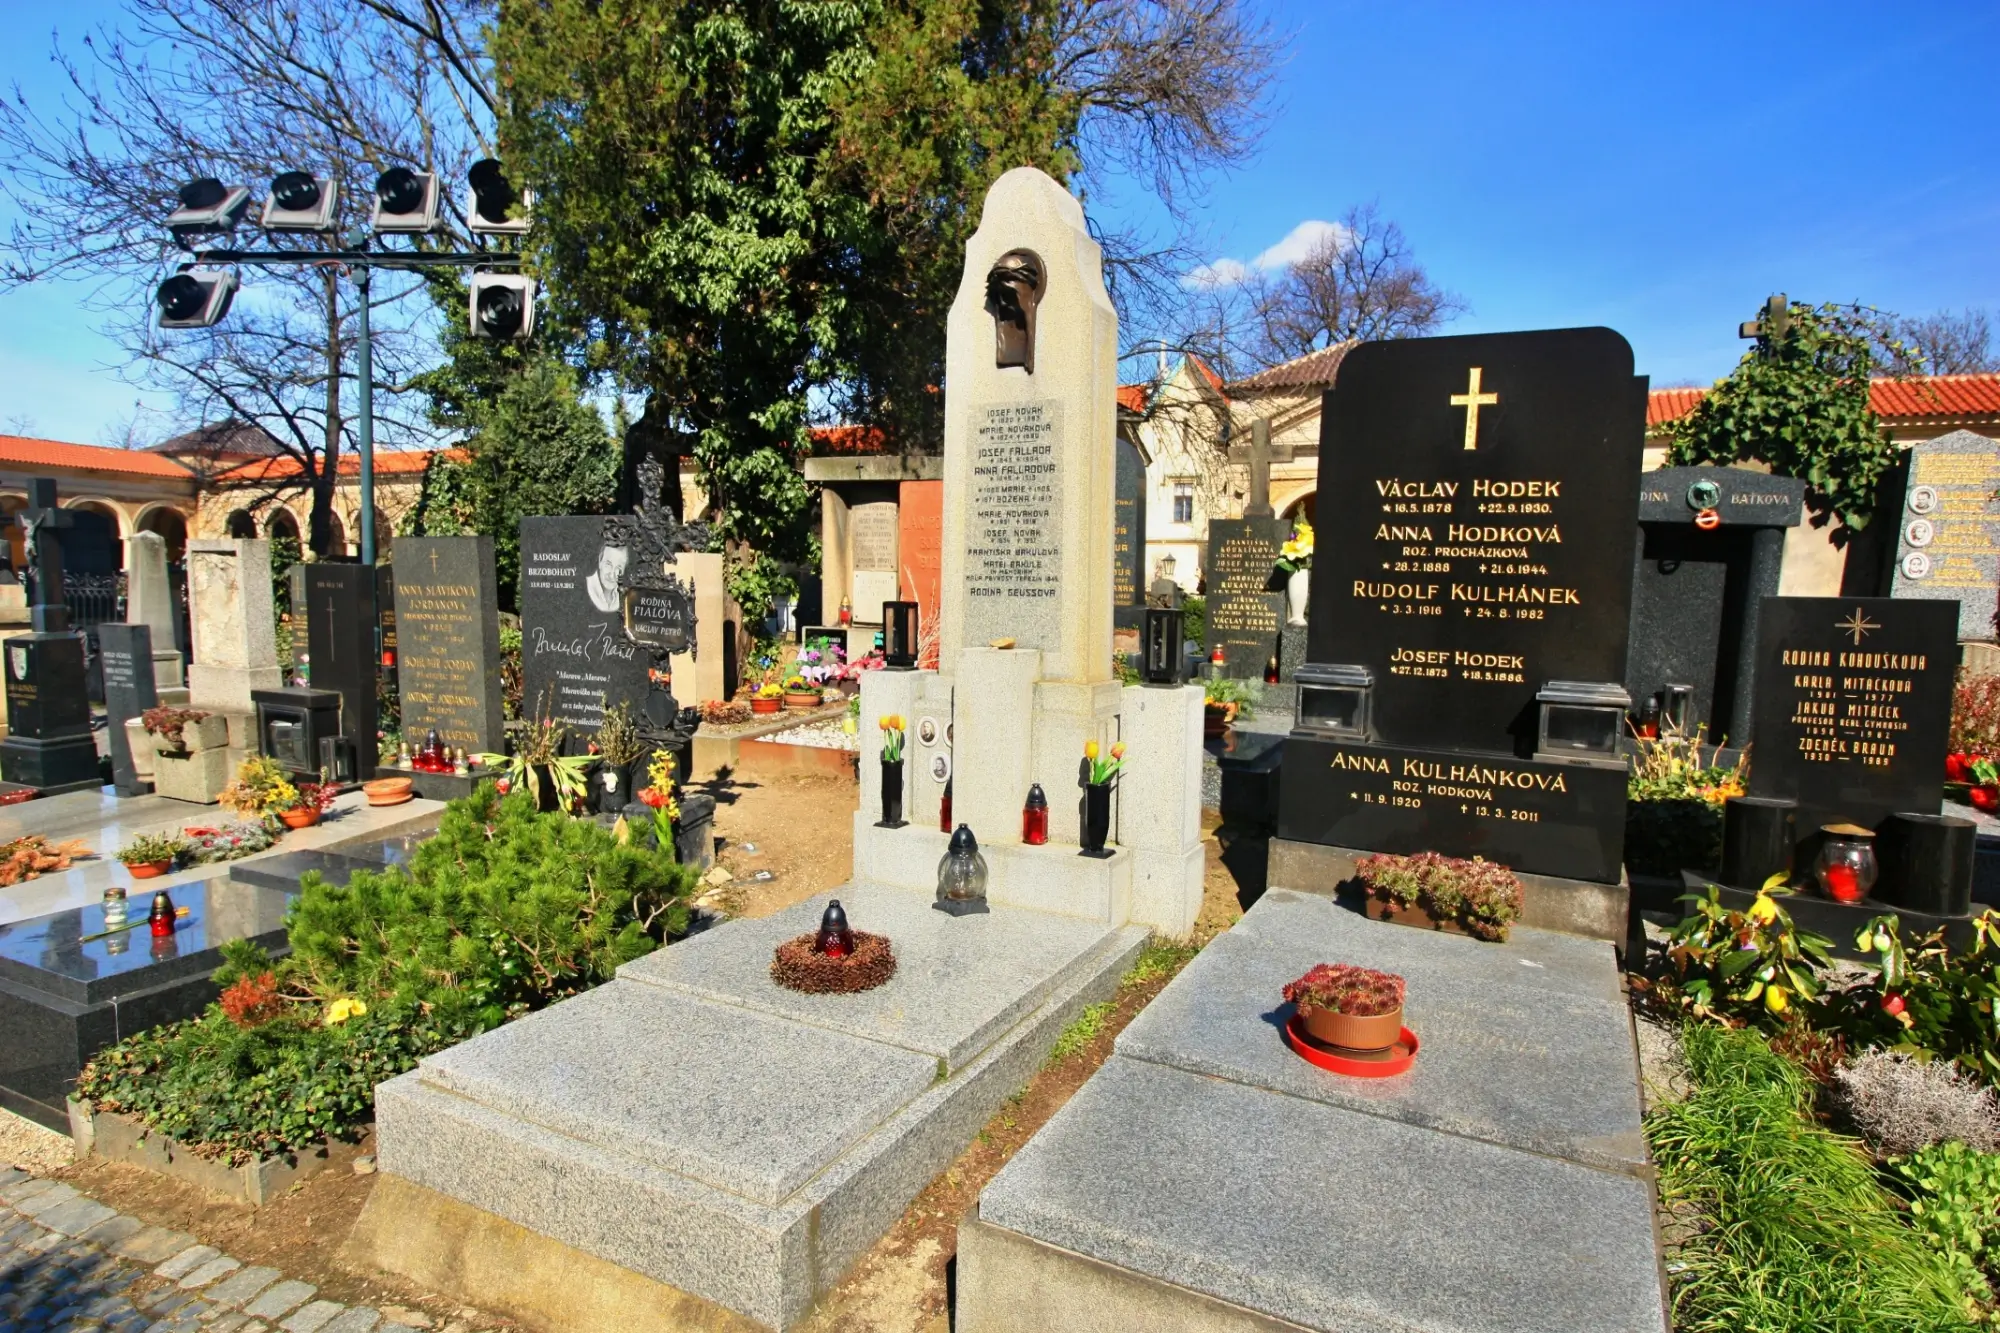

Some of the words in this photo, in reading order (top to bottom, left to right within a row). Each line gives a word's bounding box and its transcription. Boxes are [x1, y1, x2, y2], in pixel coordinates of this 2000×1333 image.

[979, 427, 1004, 435] MARIE
[978, 448, 1005, 459] JOSEF
[1009, 446, 1052, 456] FALLADA
[974, 466, 998, 476] ANNA
[1001, 485, 1026, 493] MARIE
[1375, 478, 1459, 498] VÁCLAV
[1472, 479, 1562, 498] HODEK
[983, 529, 1007, 539] JOSEF
[1374, 523, 1433, 541] ANNA
[1448, 524, 1562, 543] HODKOVÁ
[533, 552, 571, 562] RADOSLAV
[1402, 546, 1431, 557] ROZ.
[1434, 545, 1529, 559] PROCHÁZKOVÁ
[528, 567, 577, 577] BRZOBOHATÝ
[970, 587, 1001, 597] RODINA
[1353, 580, 1440, 600] RUDOLF
[1451, 582, 1581, 605] KULHÁNEK
[1418, 605, 1442, 615] 1916
[1516, 609, 1544, 619] 1982
[1390, 648, 1450, 664] JOSEF
[1454, 651, 1524, 669] HODEK
[1782, 650, 1831, 667] RODINA
[1794, 675, 1833, 689] KARLA
[1796, 701, 1835, 716] JAKUB
[1791, 716, 1834, 726] PROFESOR
[1799, 737, 1847, 753] ZDENĚK
[1853, 741, 1896, 756] BRAUN
[1330, 752, 1391, 774] ANNA
[1403, 758, 1567, 793] KULHÁNKOVÁ
[1393, 780, 1423, 793] ROZ.
[1427, 784, 1493, 801] HODKOVÁ
[1392, 796, 1421, 809] 1920
[1511, 809, 1539, 822] 2011
